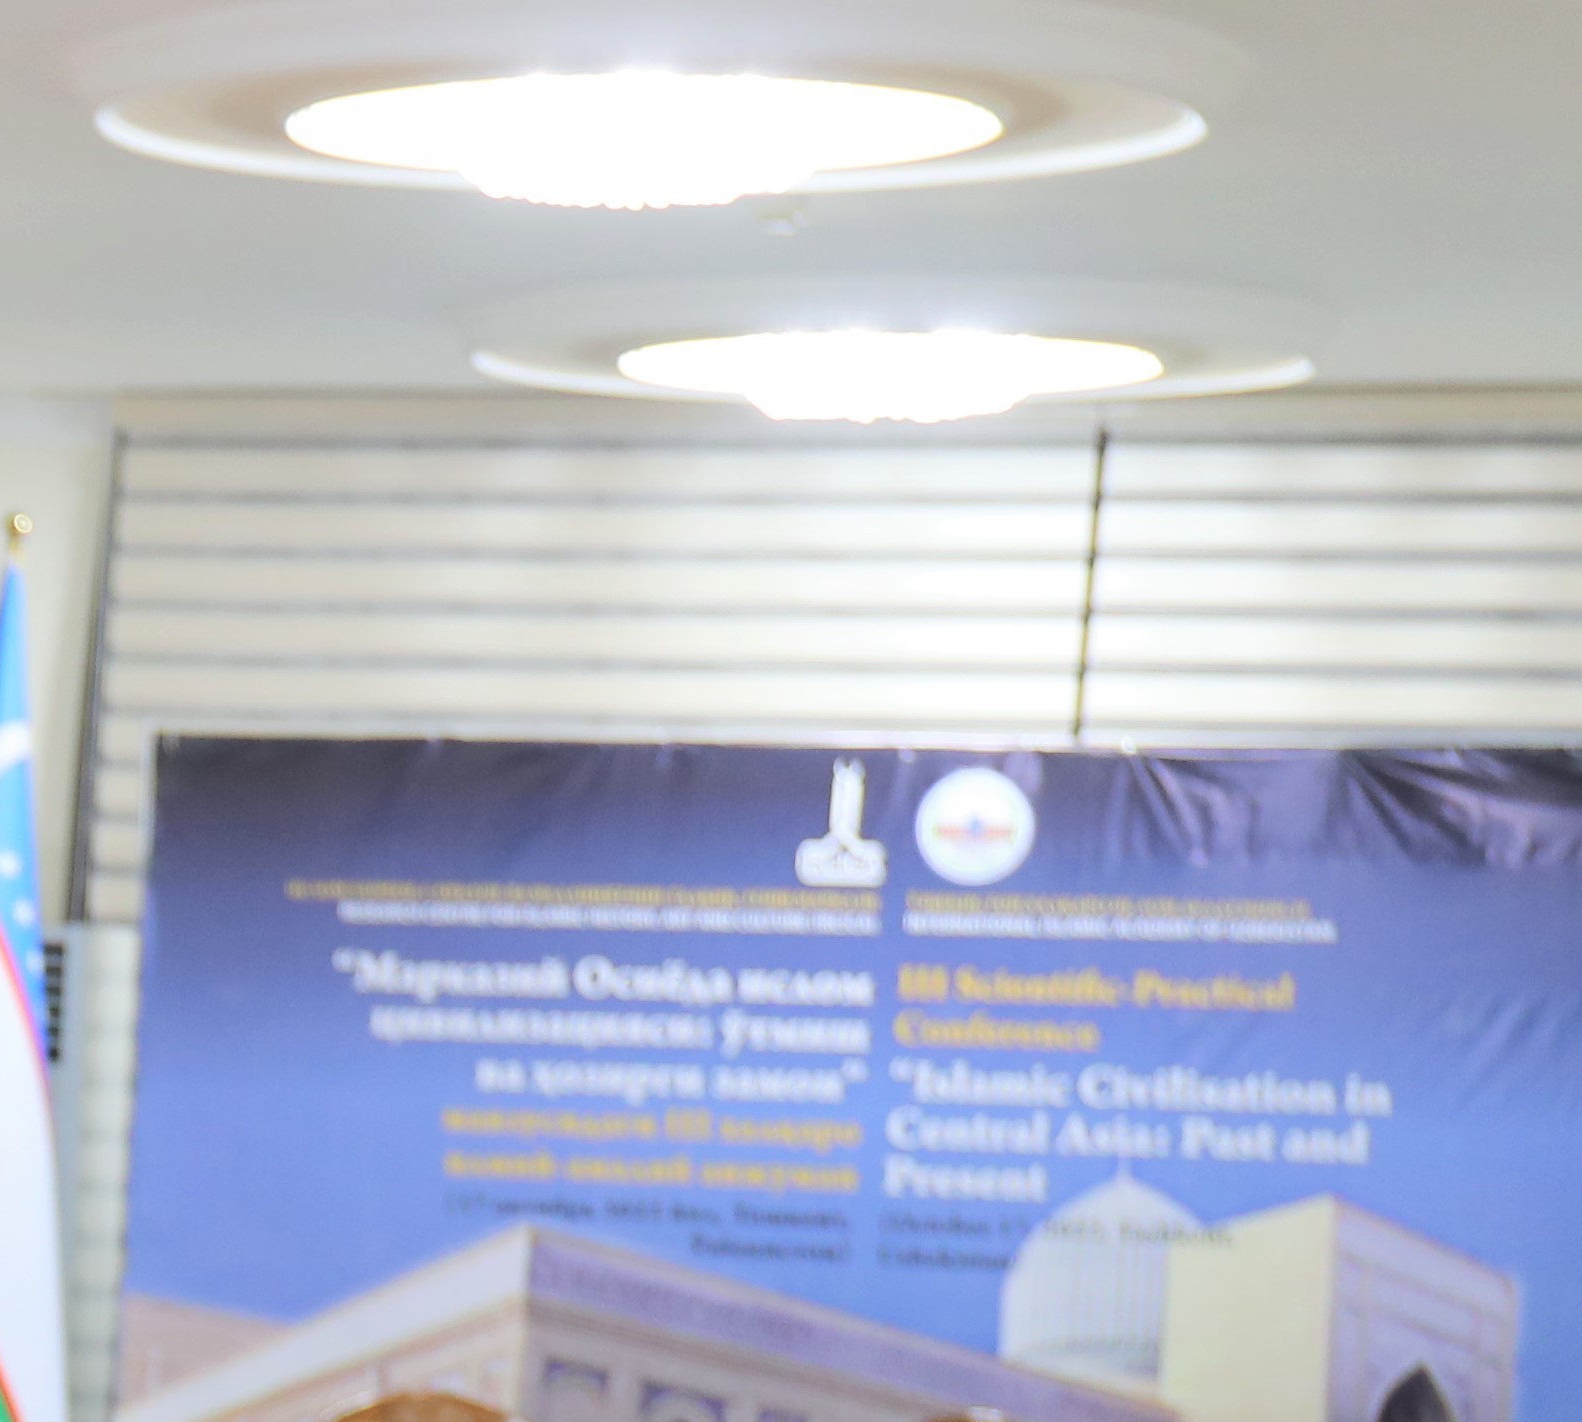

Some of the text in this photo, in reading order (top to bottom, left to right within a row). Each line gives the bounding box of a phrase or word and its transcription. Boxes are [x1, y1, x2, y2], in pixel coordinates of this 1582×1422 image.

[899, 964, 948, 1000] III
[894, 1010, 1100, 1050] Conference
[1078, 1063, 1337, 1114] Civilisation
[1344, 1071, 1393, 1117] in
[885, 1106, 1049, 1155] Central
[1181, 1115, 1276, 1162] Past
[1282, 1119, 1370, 1165] and
[882, 1155, 1048, 1202] Present
